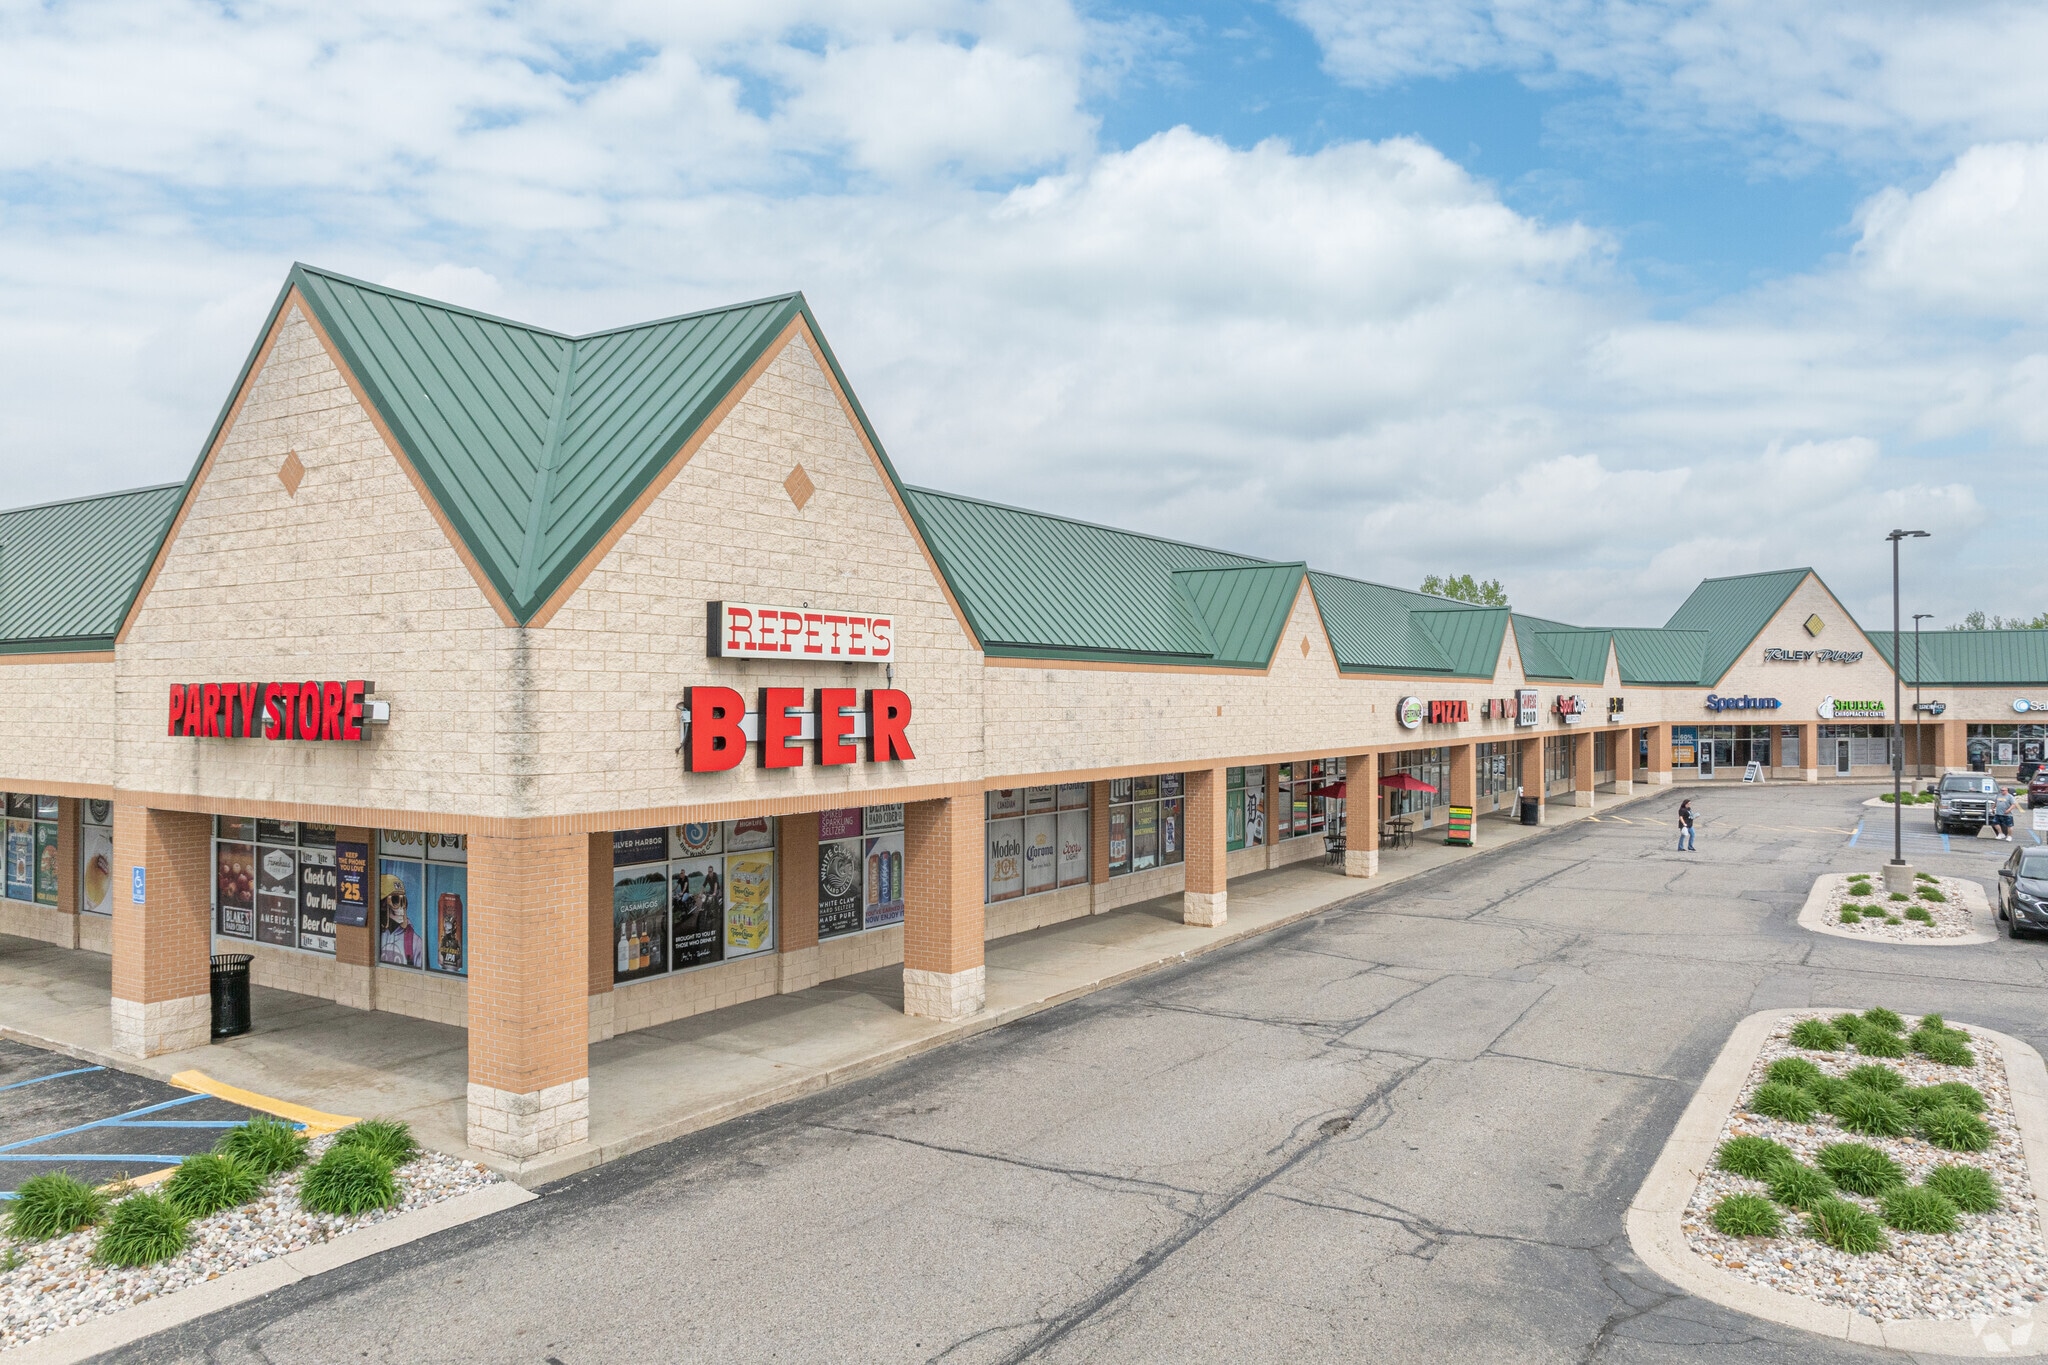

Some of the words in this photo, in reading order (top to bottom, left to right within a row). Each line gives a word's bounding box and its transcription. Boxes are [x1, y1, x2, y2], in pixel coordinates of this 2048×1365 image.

[727, 607, 891, 656] REPETE'S
[1765, 648, 1814, 663] RILEY
[1817, 649, 1863, 663] Plaza
[1707, 694, 1777, 712] Spectrum
[1834, 700, 1886, 711] SHULUGA
[168, 682, 258, 738] PARTY
[264, 680, 364, 741] STORE
[1431, 700, 1469, 724] PIZZA
[1523, 712, 1536, 722] FOOD
[692, 686, 915, 773] BEER
[1110, 778, 1131, 802] Lite
[822, 816, 854, 828] SPARKLING
[869, 812, 882, 824] HARD
[883, 812, 898, 823] CIDER
[822, 826, 846, 836] SELTZER
[634, 836, 662, 846] HARBOR
[1063, 840, 1082, 855] Coors
[680, 842, 706, 857] BREWING
[992, 840, 1020, 859] Modelo
[1026, 846, 1053, 862] Corona
[303, 852, 312, 862] Lite
[318, 853, 328, 864] Lite
[821, 848, 833, 881] WHITE
[304, 868, 324, 884] Check
[327, 870, 336, 887] Ou
[341, 882, 360, 900] $25
[306, 892, 320, 908] Our
[321, 894, 336, 910] New
[620, 901, 658, 913] CASAMIGOS
[819, 899, 837, 908] WHITE
[839, 896, 855, 906] CLAW
[835, 903, 855, 912] SELTZER
[226, 910, 250, 924] BLAKE'S
[260, 913, 296, 927] AMERICA'S
[302, 915, 319, 930] Beer
[321, 917, 336, 933] Cav
[819, 914, 837, 924] MADE
[840, 911, 855, 920] PURE
[866, 914, 879, 924] NOW
[881, 911, 898, 921] ENJOY
[303, 936, 312, 946] Lite
[318, 938, 328, 948] Lite
[675, 933, 695, 943] BROUGHT
[700, 937, 712, 945] DRINK
[445, 953, 456, 962] IPA
